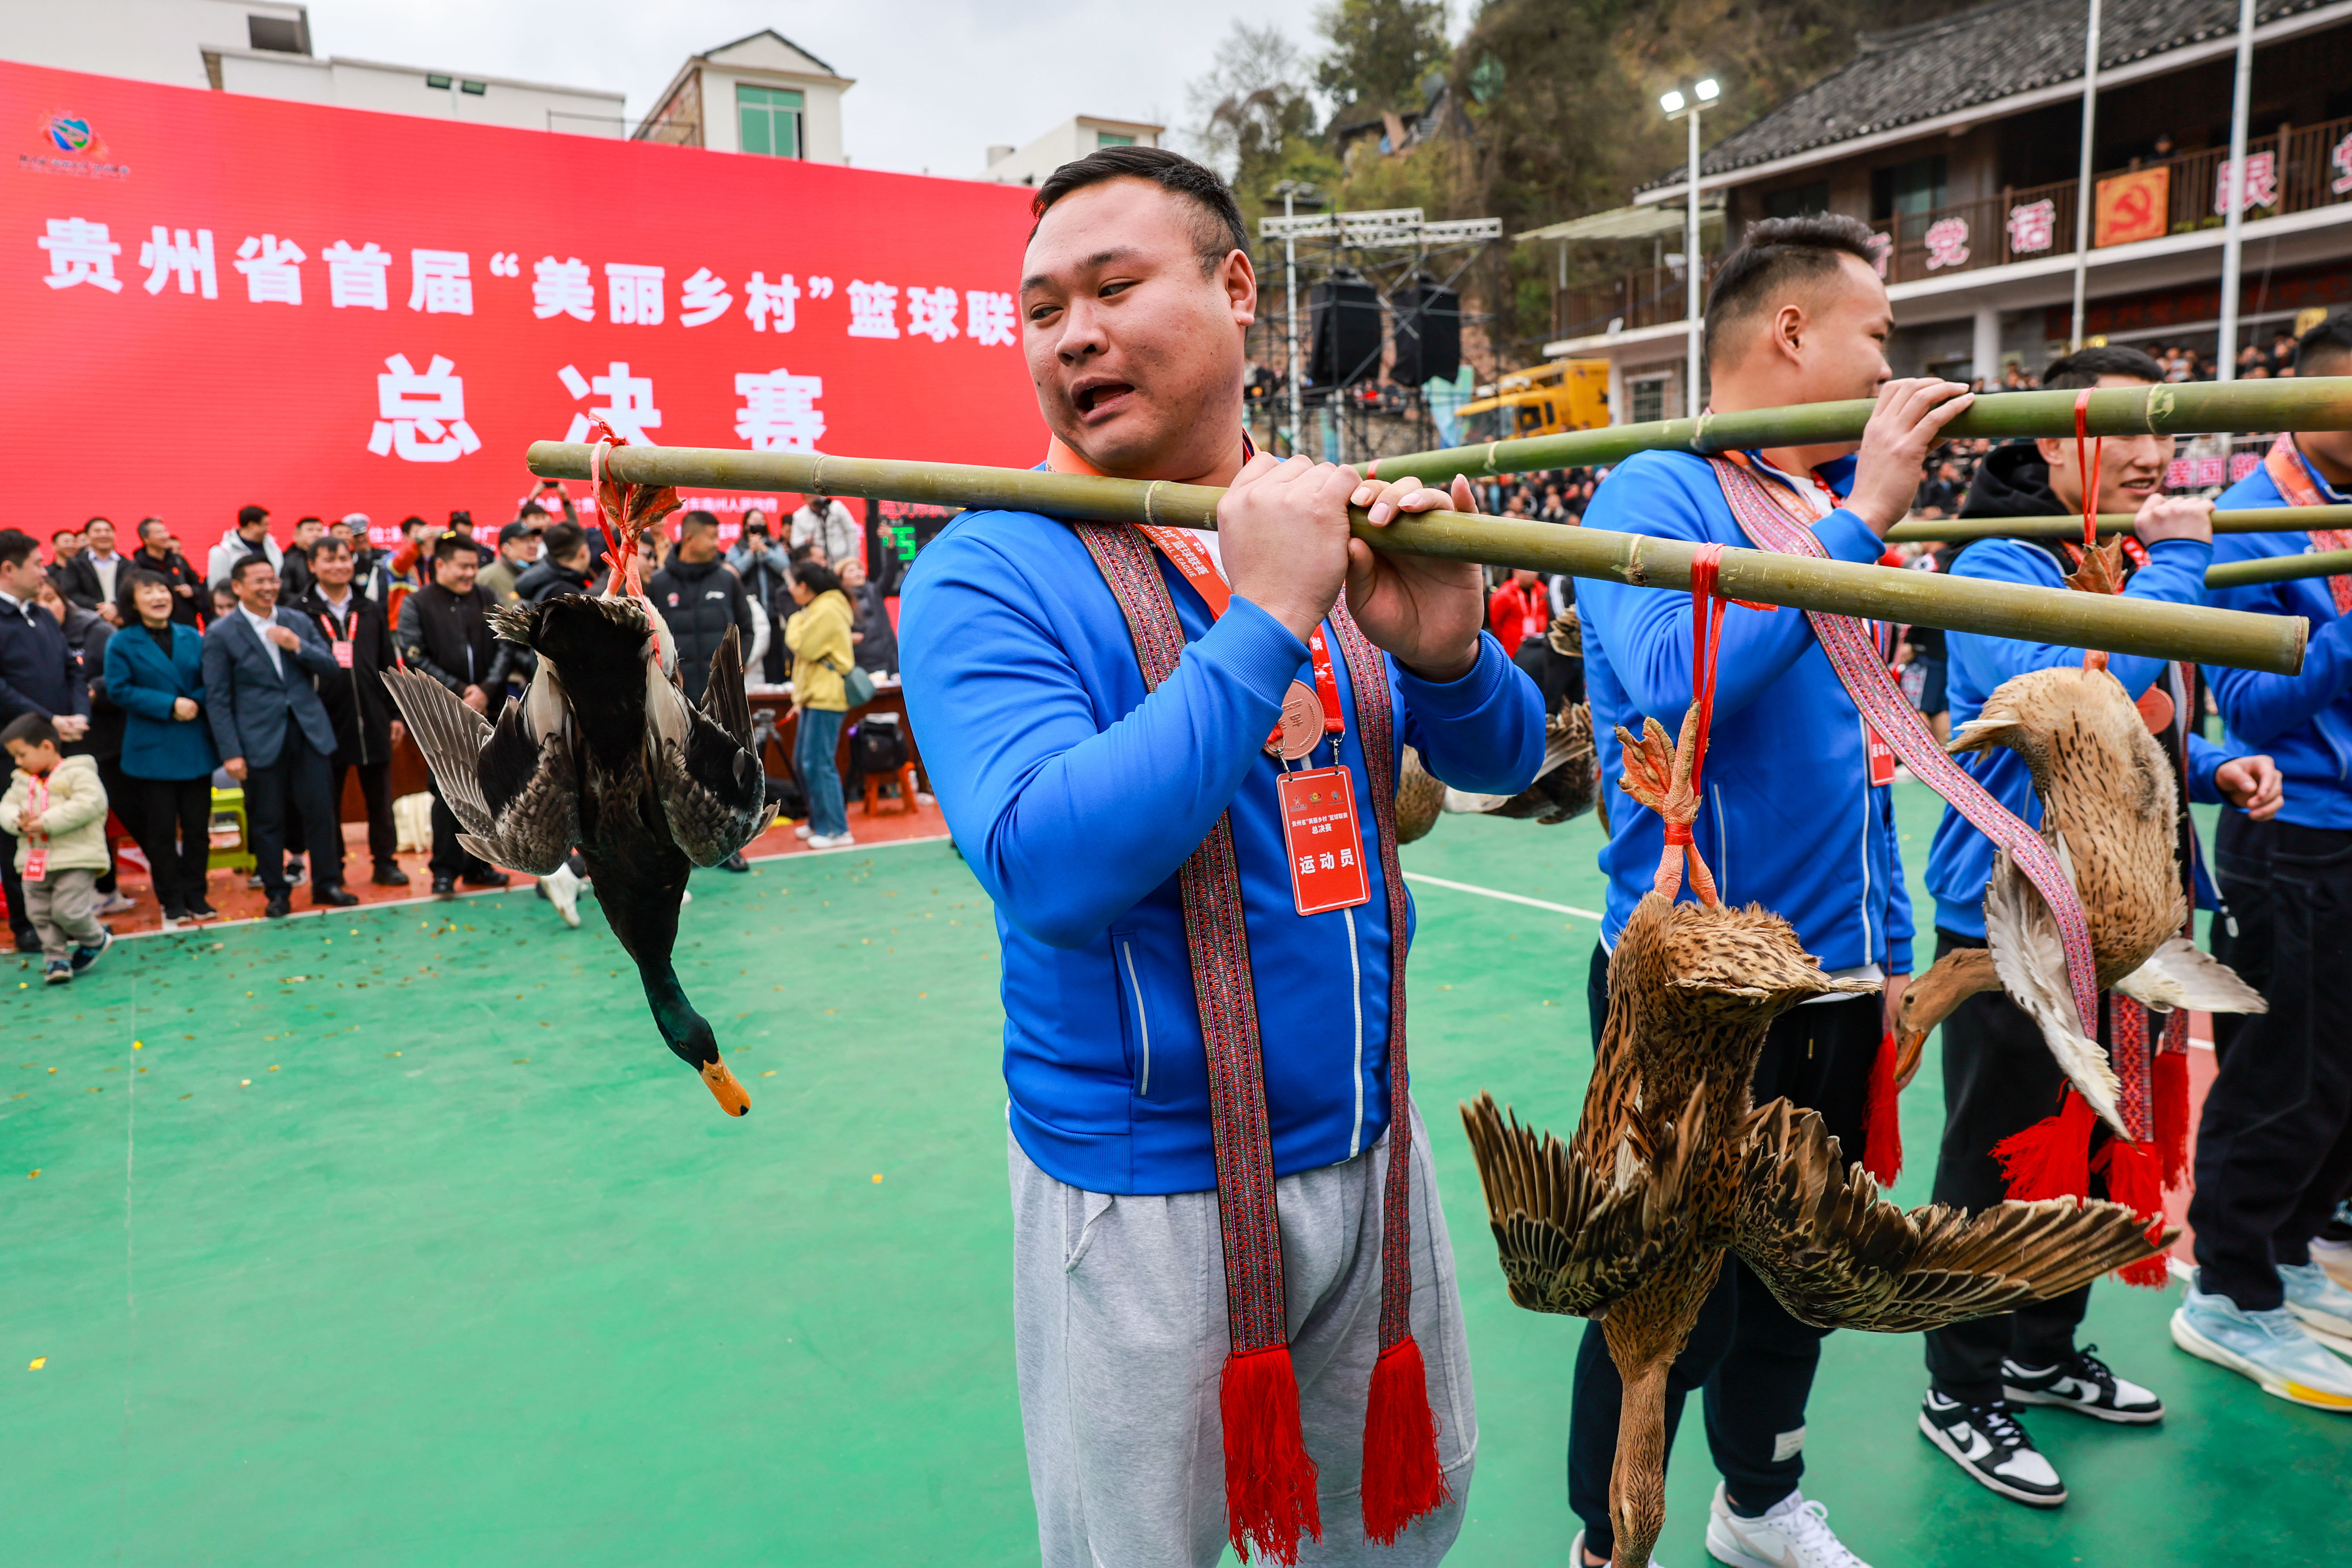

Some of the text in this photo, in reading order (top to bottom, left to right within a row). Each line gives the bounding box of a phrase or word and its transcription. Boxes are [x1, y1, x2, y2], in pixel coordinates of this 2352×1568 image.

[367, 353, 826, 463] 总决赛
[1140, 524, 1198, 578] ASKETBALL LEAGUE
[1312, 823, 1332, 835] 总决赛
[1299, 848, 1355, 875] 运动员
